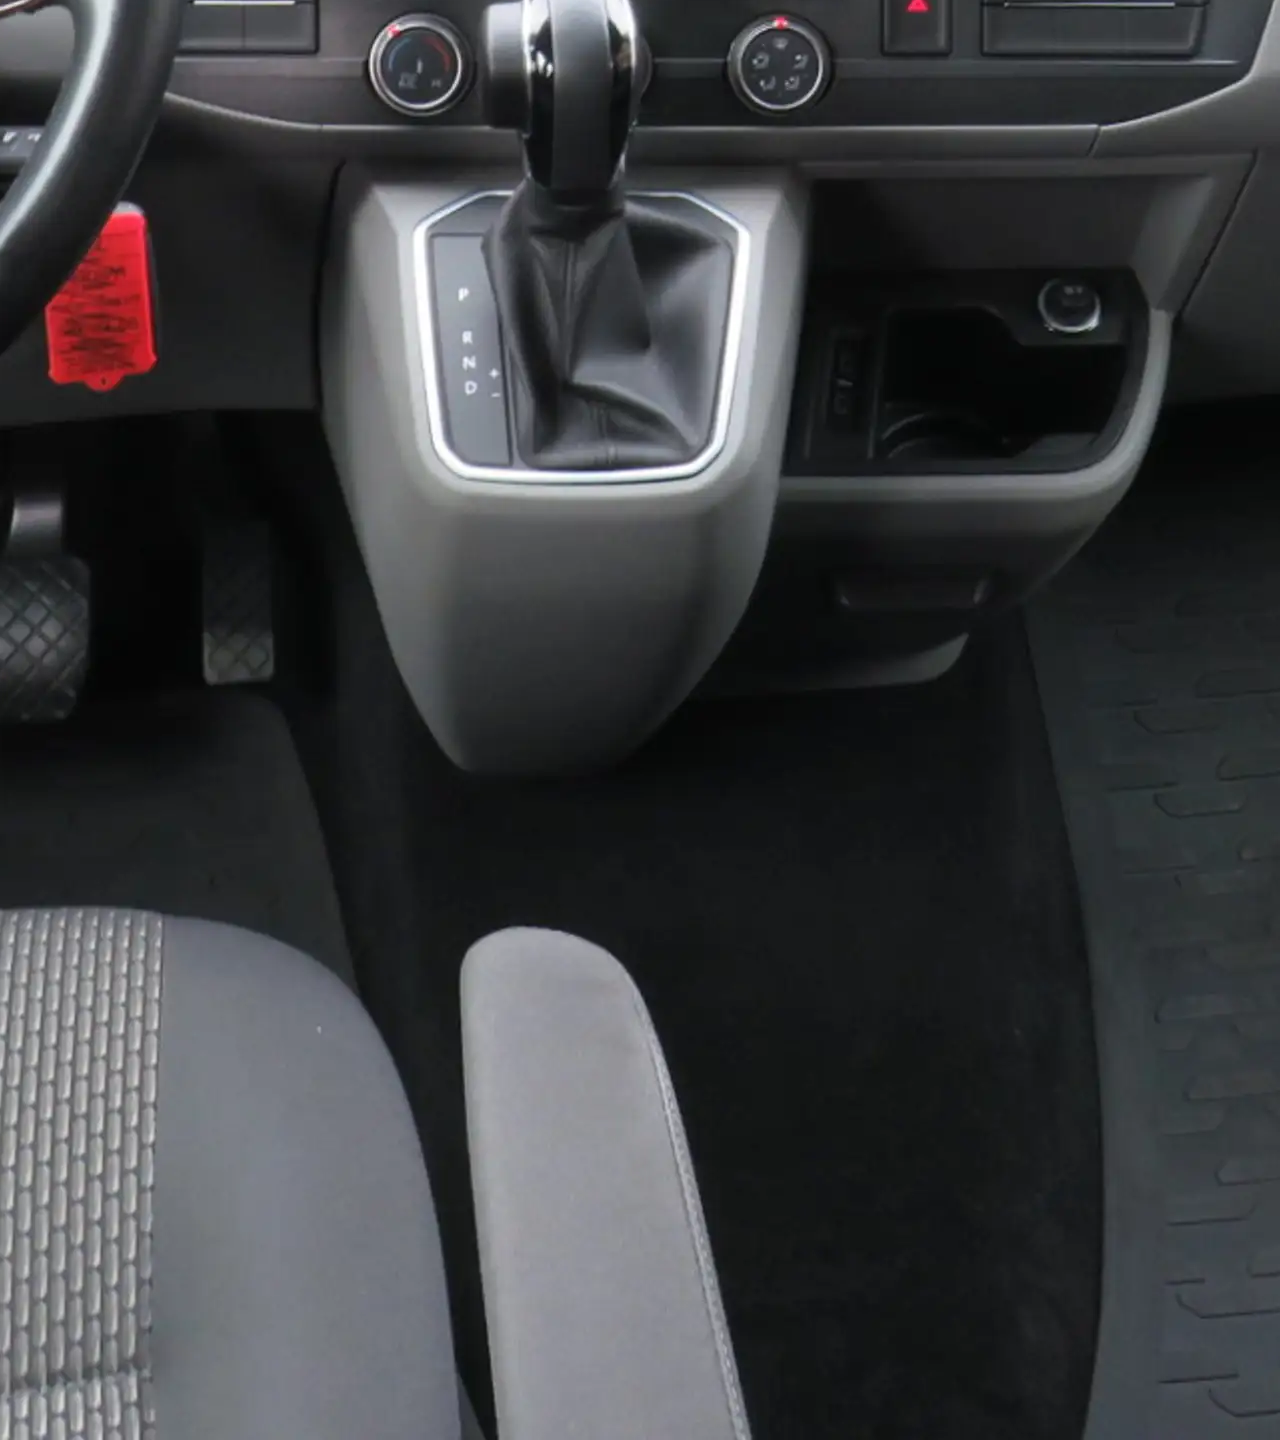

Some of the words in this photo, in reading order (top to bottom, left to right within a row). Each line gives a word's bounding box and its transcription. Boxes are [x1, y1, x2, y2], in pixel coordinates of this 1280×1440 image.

[458, 287, 469, 302] P
[462, 330, 473, 344] R
[462, 355, 476, 371] N
[464, 380, 478, 396] D
